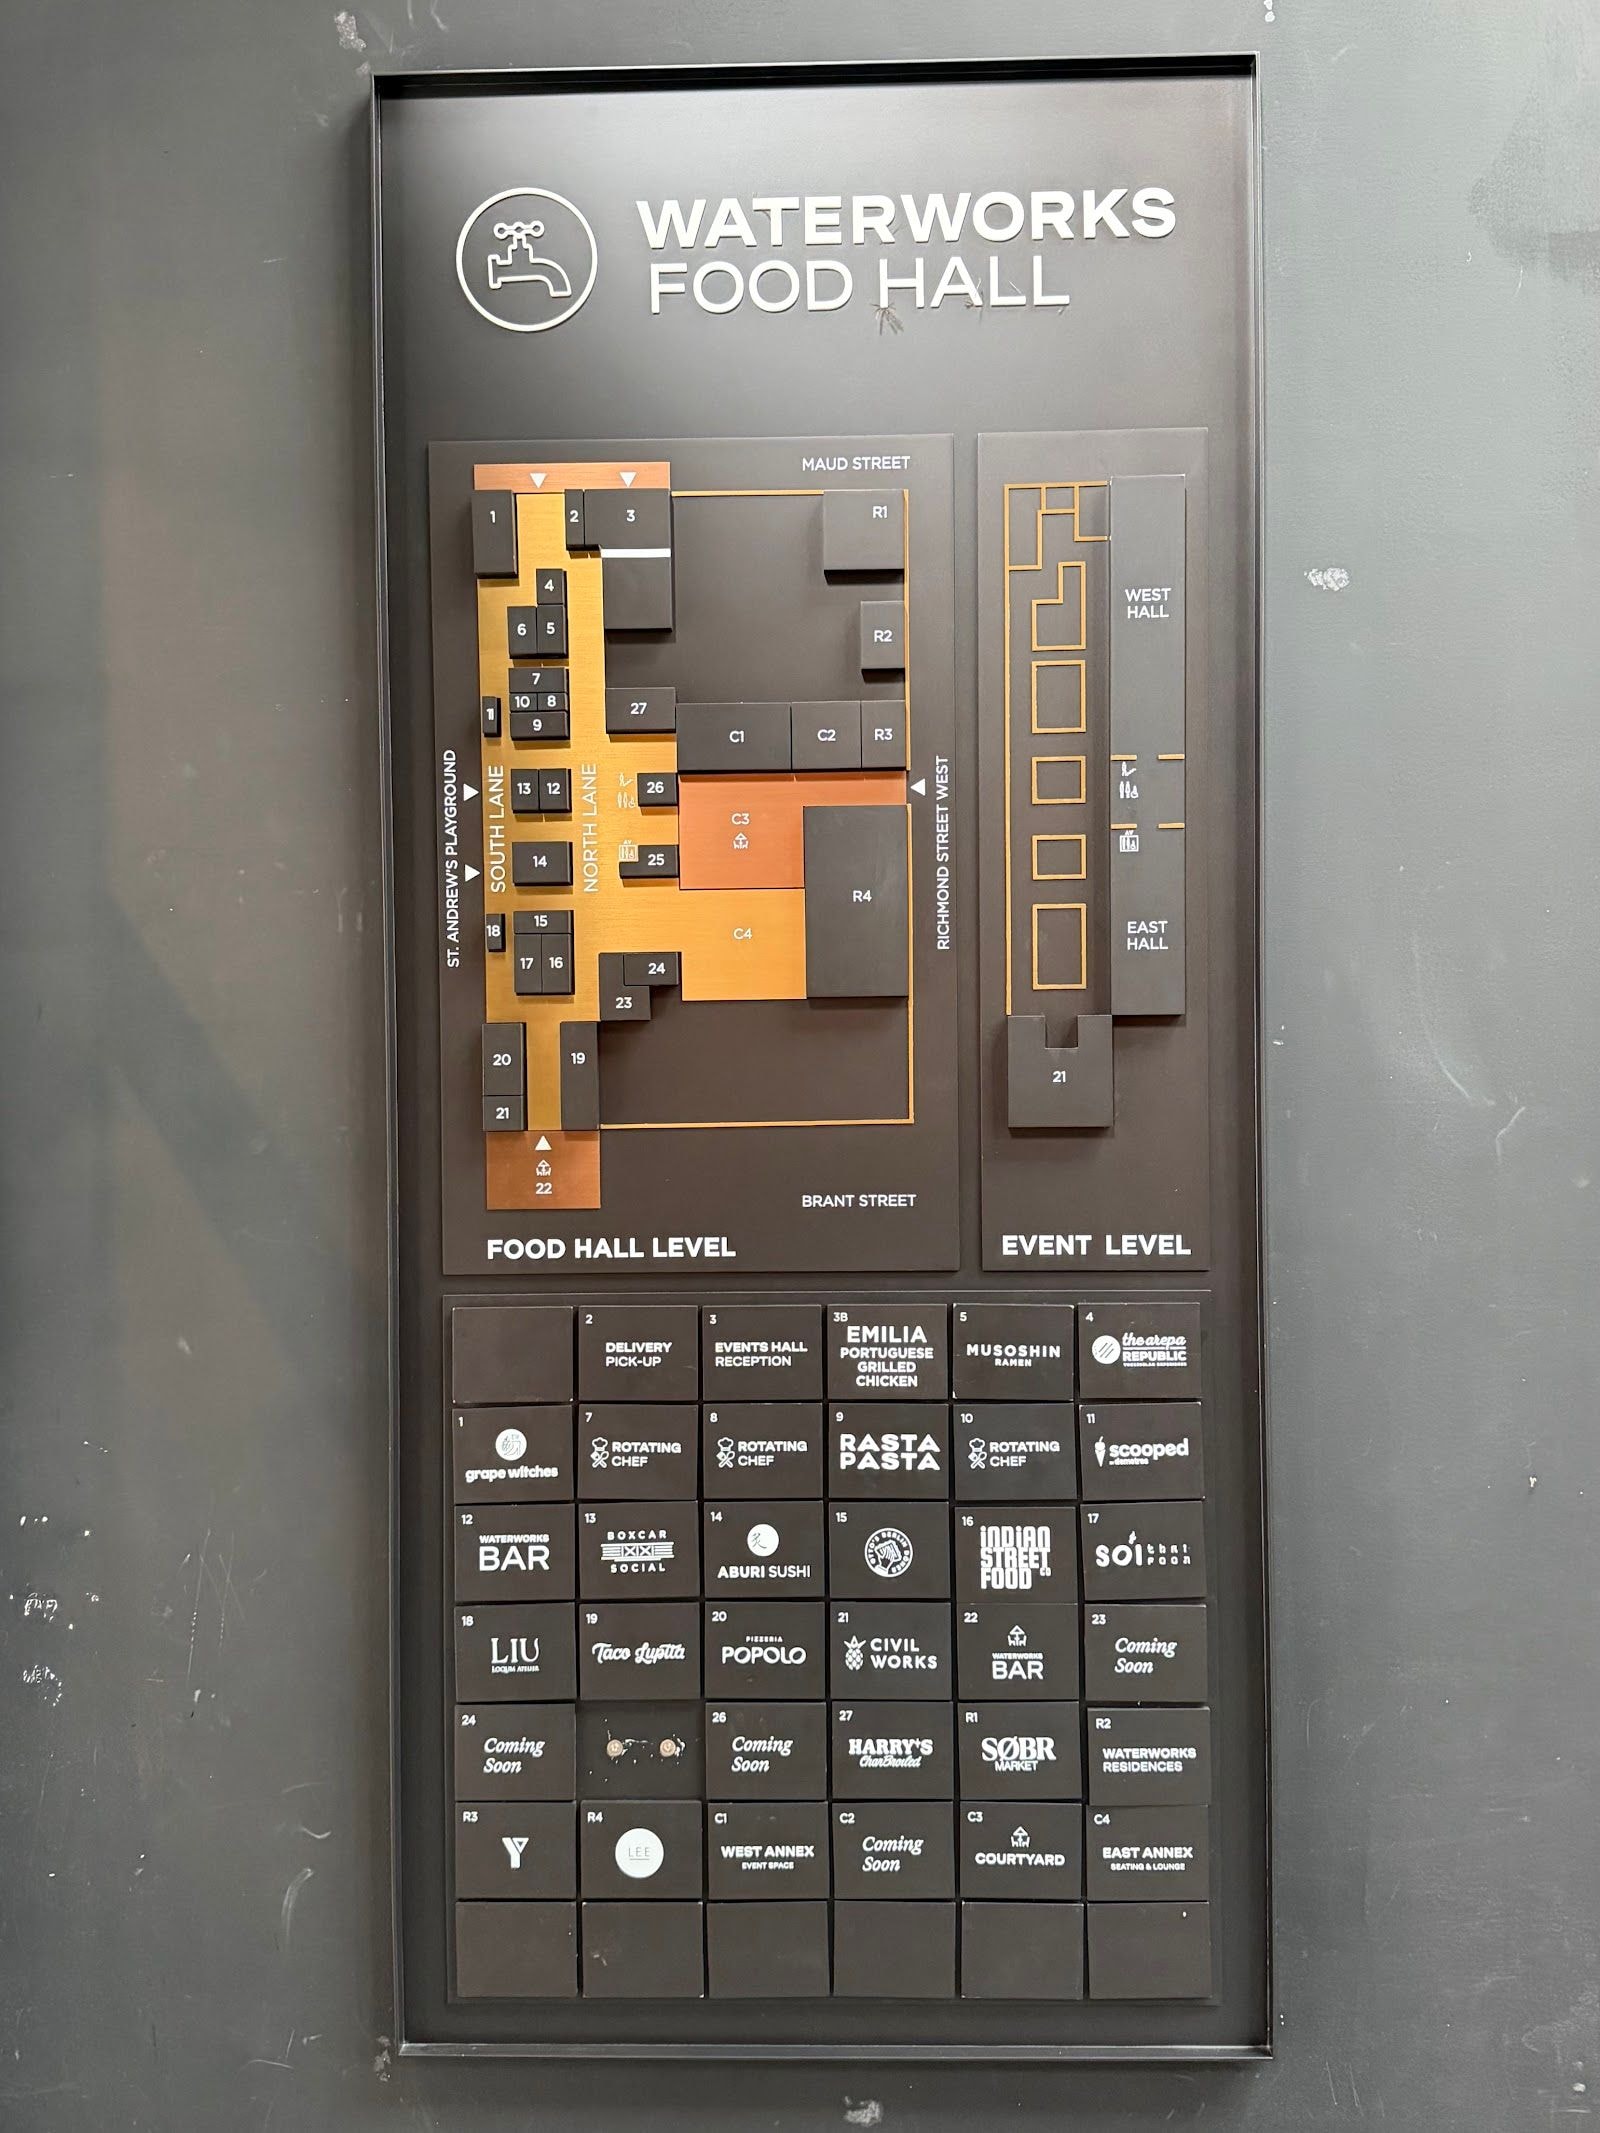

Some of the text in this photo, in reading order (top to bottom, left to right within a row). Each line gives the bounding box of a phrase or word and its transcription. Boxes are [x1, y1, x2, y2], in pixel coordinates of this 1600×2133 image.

[636, 188, 1175, 248] WATERWORKS
[651, 256, 1069, 313] FOOD HALL
[803, 456, 910, 471] MAUD STREET
[490, 511, 495, 523] 1
[570, 510, 578, 522] 2
[627, 510, 635, 522] 3
[873, 506, 887, 518] R1
[545, 579, 554, 591] 4
[1125, 588, 1171, 602] WEST
[1128, 605, 1169, 618] HALL
[518, 624, 526, 635] 6
[547, 622, 555, 634] 5
[874, 630, 892, 642] R2
[532, 673, 540, 684] 7
[515, 696, 530, 708] 10
[548, 695, 556, 707] 8
[631, 703, 647, 714] 27
[533, 719, 542, 731] 9
[730, 731, 744, 742] C1
[818, 729, 835, 741] C2
[875, 728, 892, 740] R3
[517, 783, 531, 794] 13
[547, 783, 560, 794] 12
[647, 781, 664, 793] 26
[732, 813, 749, 824] C3
[488, 766, 505, 892] SOUTH LANE
[581, 764, 598, 891] NORTH LANE
[936, 756, 949, 949] RICHMOND STREET WEST
[444, 750, 459, 967] ST. ANDREW'S PLAYGROUND
[533, 856, 547, 867] 14
[648, 854, 664, 865] 25
[853, 890, 872, 902] R4
[534, 915, 547, 927] 15
[486, 925, 500, 937] 18
[1128, 921, 1168, 933] EAST
[734, 928, 752, 939] C4
[1128, 937, 1168, 950] HALL
[520, 958, 533, 969] 17
[549, 957, 563, 968] 16
[649, 963, 665, 974] 24
[616, 997, 632, 1008] 23
[493, 1054, 511, 1065] 20
[571, 1053, 585, 1064] 19
[1053, 1071, 1065, 1082] 21
[496, 1107, 509, 1119] 21
[536, 1183, 552, 1194] 22
[803, 1194, 916, 1207] BRANT STREET
[488, 1237, 736, 1259] FOOD HALL LEVEL
[1003, 1235, 1191, 1255] EVENT LEVEL
[834, 1312, 848, 1322] 3B
[848, 1326, 927, 1343] EMILIA
[1122, 1332, 1186, 1349] the arepa
[606, 1342, 672, 1352] DELIVERY
[715, 1342, 808, 1352] EVENTS HALL
[841, 1347, 933, 1358] PORTUGUESE
[967, 1344, 1060, 1357] MUSOSHIN
[606, 1356, 661, 1367] PICK-UP
[716, 1356, 791, 1366] RECEPTION
[1123, 1351, 1186, 1361] REPUBLIC
[858, 1361, 916, 1372] GRILLED
[995, 1358, 1031, 1366] RAMEN
[856, 1375, 917, 1387] CHICKEN
[612, 1442, 681, 1453] ROTATING
[738, 1441, 807, 1452] ROTATING
[840, 1434, 940, 1452] RASTA
[990, 1441, 1060, 1452] ROTATING
[1109, 1438, 1189, 1462] scooped
[612, 1456, 648, 1466] CHEF
[738, 1455, 774, 1466] CHEF
[840, 1452, 940, 1470] PASTA
[990, 1456, 1026, 1467] CHEF
[466, 1465, 558, 1483] grape witches
[1088, 1513, 1099, 1523] 17
[479, 1534, 549, 1543] WATERWORKS
[608, 1530, 666, 1540] BOXCAR
[480, 1546, 549, 1571] BAR
[980, 1546, 1050, 1569] STREET
[611, 1563, 665, 1573] SOCIAL
[718, 1565, 810, 1578] ABURI SUSHI
[980, 1568, 1032, 1589] FOOD
[462, 1616, 473, 1626] 18
[586, 1614, 597, 1624] 19
[712, 1611, 727, 1621] 20
[838, 1612, 848, 1622] 21
[964, 1612, 977, 1622] 22
[1092, 1614, 1106, 1624] 23
[491, 1638, 539, 1663] LIU
[871, 1638, 919, 1652] CIVIL
[1115, 1638, 1177, 1658] Coming
[592, 1643, 631, 1662] Taco
[722, 1647, 806, 1664] POPOLO
[871, 1655, 937, 1669] WORKS
[1115, 1658, 1153, 1673] Soon
[992, 1661, 1043, 1679] BAR
[462, 1715, 476, 1725] 24
[712, 1712, 726, 1722] 26
[839, 1710, 852, 1721] 27
[966, 1712, 977, 1722] R1
[1096, 1718, 1111, 1729] R2
[484, 1737, 545, 1757] Coming
[732, 1736, 793, 1756] Coming
[849, 1738, 933, 1755] HARRY'S
[1103, 1748, 1196, 1759] WATERWORKS
[484, 1758, 521, 1773] Soon
[732, 1756, 769, 1772] Soon
[995, 1761, 1038, 1771] MARKET
[1103, 1761, 1182, 1772] RESIDENCES
[463, 1812, 478, 1822] R3
[588, 1812, 603, 1822] R4
[715, 1813, 727, 1823] C1
[840, 1813, 855, 1823] C2
[968, 1812, 983, 1822] C3
[1094, 1814, 1110, 1824] C4
[863, 1836, 923, 1855] Coming
[629, 1847, 650, 1857] LEE
[721, 1846, 814, 1857] WEST ANNEX
[1103, 1847, 1193, 1858] EAST ANNEX
[862, 1856, 900, 1871] Soon
[975, 1853, 1065, 1865] COURTYARD
